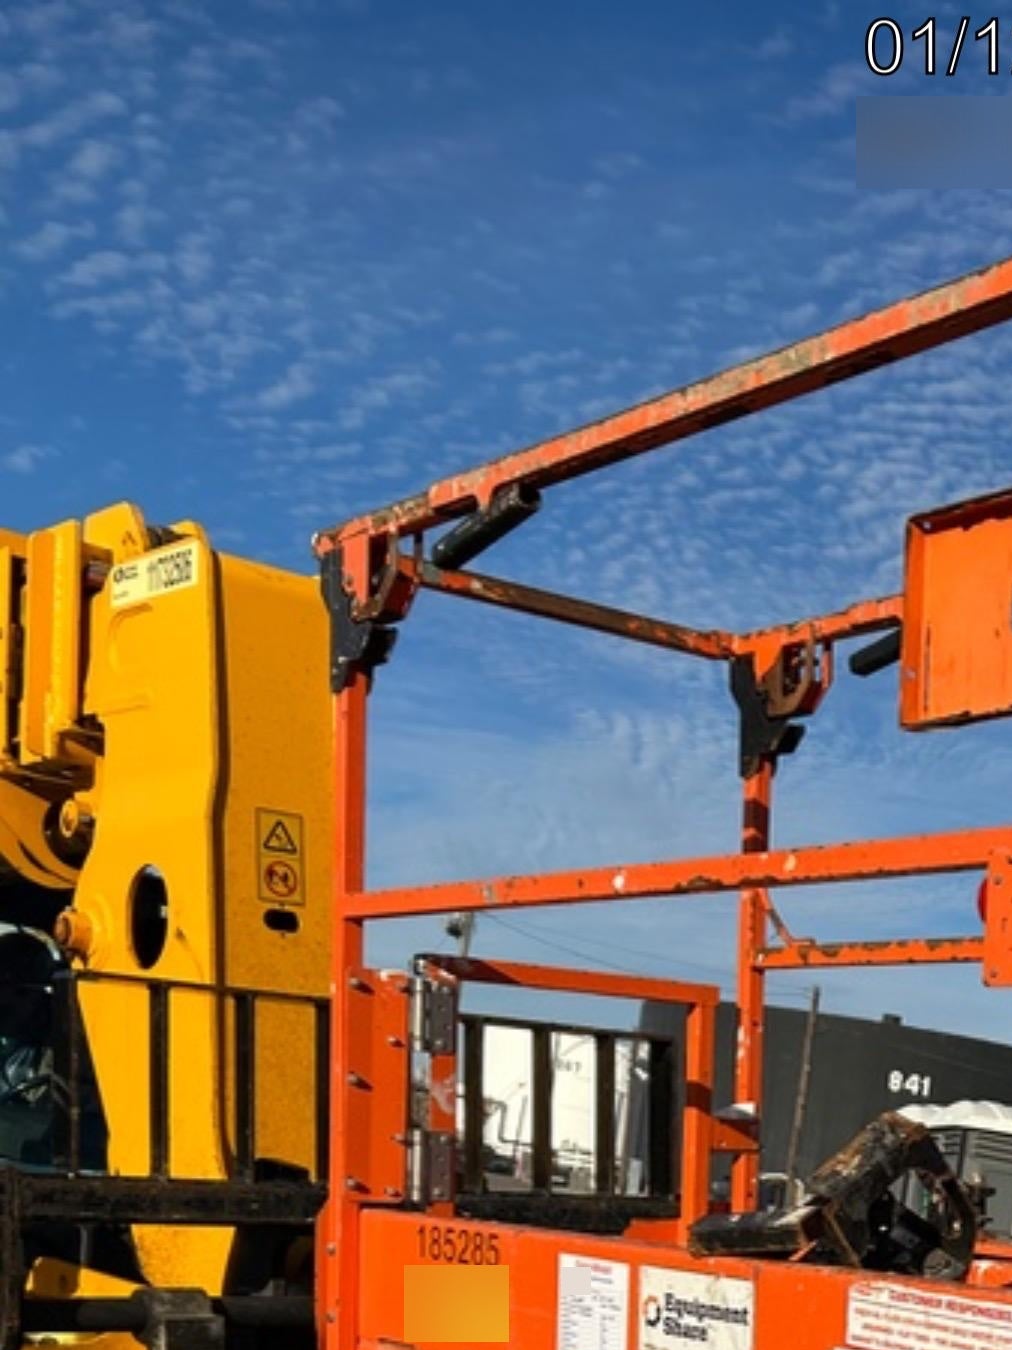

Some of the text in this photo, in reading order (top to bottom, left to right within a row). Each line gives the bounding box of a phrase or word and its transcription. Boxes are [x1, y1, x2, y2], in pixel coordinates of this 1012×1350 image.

[888, 1070, 932, 1097] 841
[416, 1226, 501, 1266] 185285
[664, 1292, 749, 1327] Equipment
